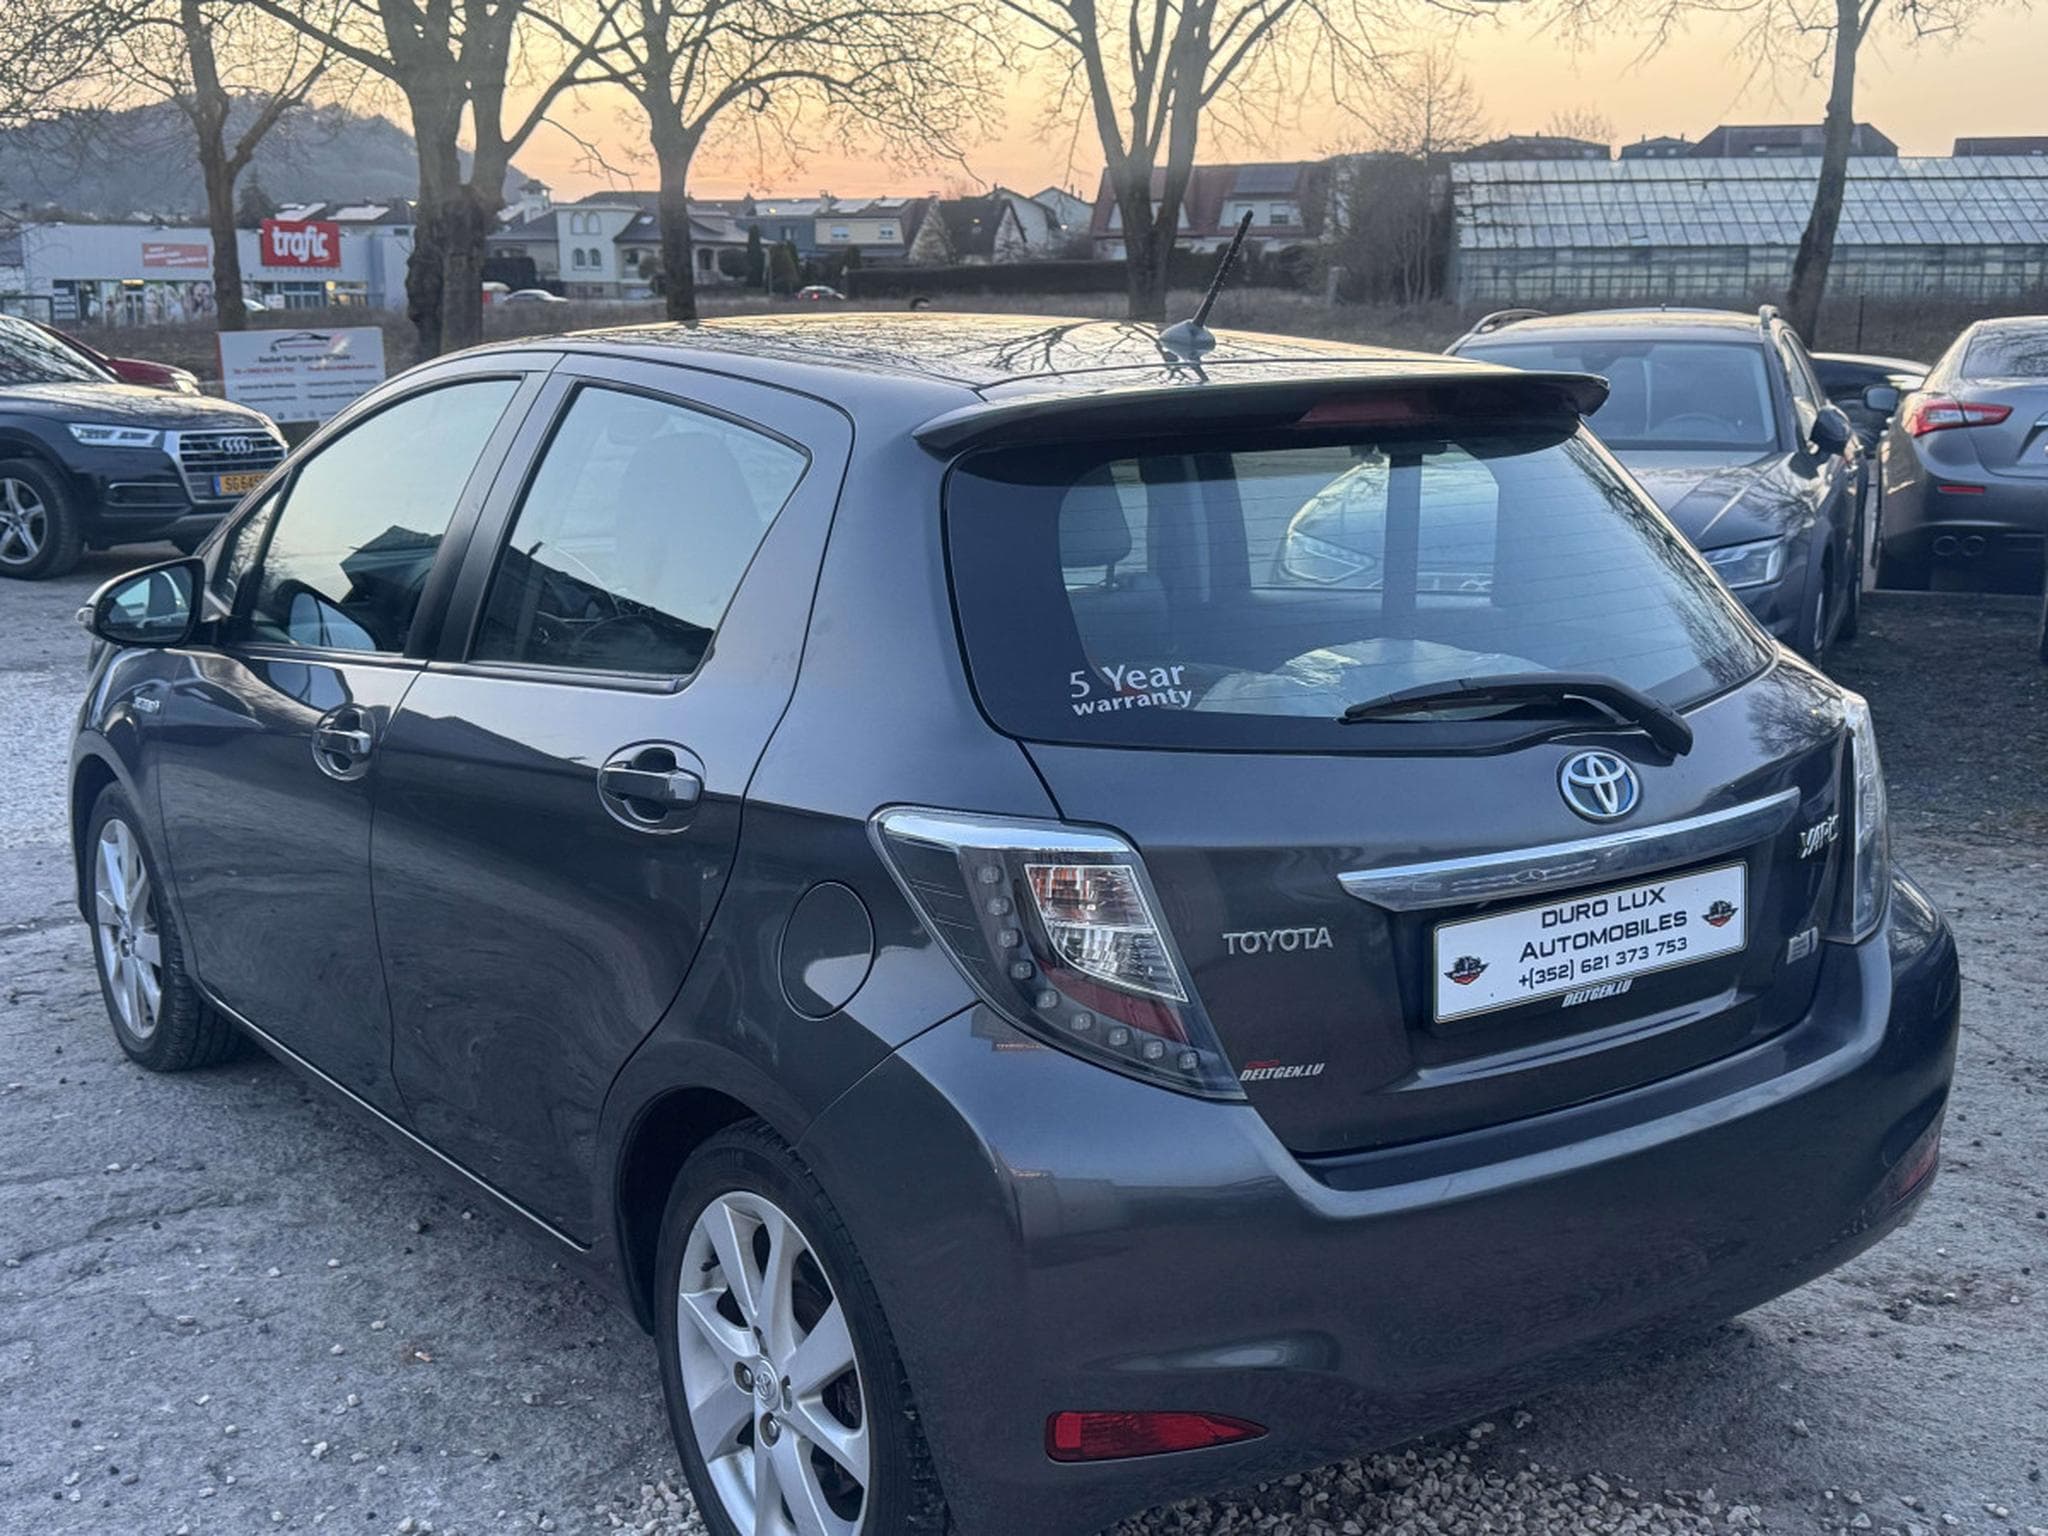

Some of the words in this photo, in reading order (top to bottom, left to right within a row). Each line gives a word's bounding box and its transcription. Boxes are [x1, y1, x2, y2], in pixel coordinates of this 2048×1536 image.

[272, 225, 329, 263] trafic
[1069, 670, 1091, 698] 5
[1101, 664, 1185, 692] Year
[1072, 687, 1192, 716] warranty
[1541, 899, 1608, 929] DURO
[1617, 887, 1666, 912] LUX
[1222, 926, 1333, 955] TOYOTA
[1519, 911, 1687, 963] AUTOMOBILES
[1518, 965, 1575, 990] +(352)
[1580, 955, 1609, 974] 621
[1615, 946, 1649, 966] 373
[1656, 937, 1687, 956] 753
[1239, 1062, 1326, 1082] DELTGEN.LU
